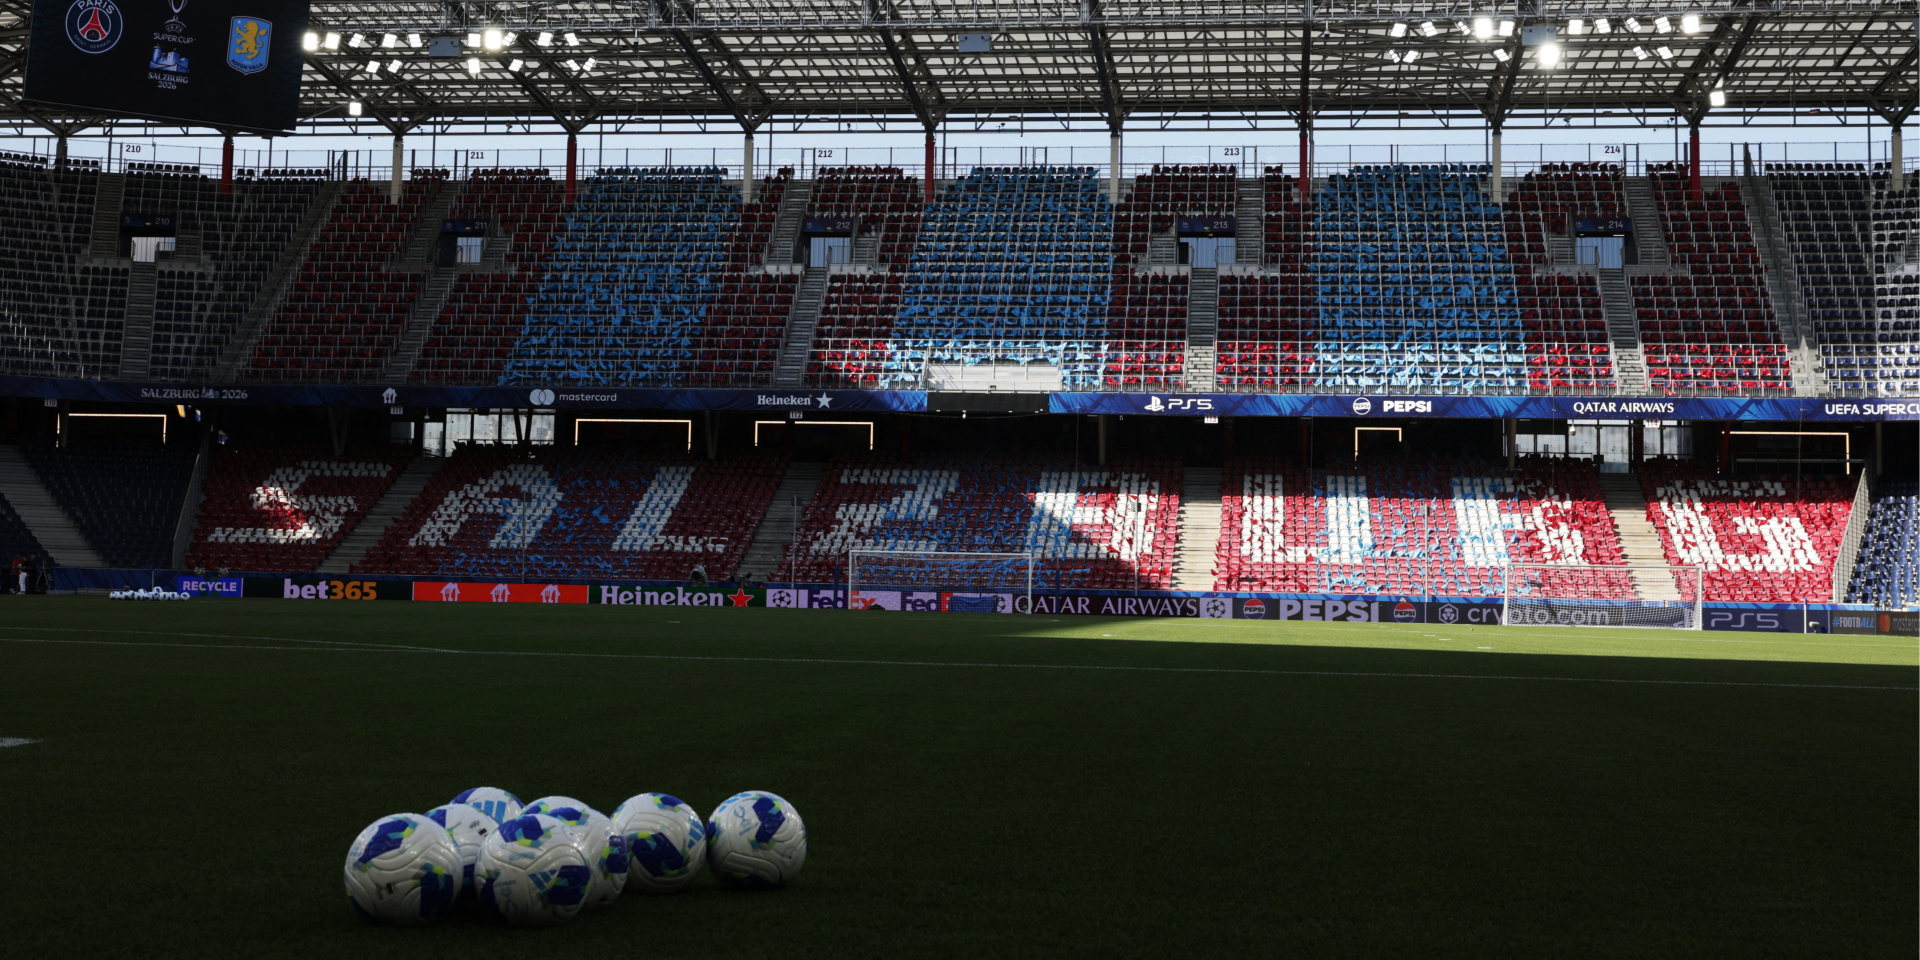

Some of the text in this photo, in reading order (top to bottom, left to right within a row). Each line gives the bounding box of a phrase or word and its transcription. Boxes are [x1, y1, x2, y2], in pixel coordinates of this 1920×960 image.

[78, 0, 114, 14] PARIS
[153, 32, 194, 44] SUPER CUP
[231, 59, 248, 69] ASTON
[248, 62, 264, 70] VILLA
[148, 72, 188, 84] SALZBURG
[158, 81, 177, 90] 2026
[125, 145, 141, 153] 210
[818, 150, 833, 158] 212
[1224, 148, 1240, 156] 213
[1604, 145, 1620, 154] 214
[471, 151, 485, 159] 211
[155, 217, 170, 226] 210
[474, 221, 488, 230] 211
[836, 221, 850, 230] 212
[1213, 220, 1228, 229] 213
[1608, 220, 1624, 229] 214
[140, 387, 248, 399] SALZBURG 2026
[559, 392, 617, 402] mastercard
[757, 395, 811, 405] Heineken
[1168, 399, 1213, 410] PS5
[1383, 400, 1432, 413] PEPSI
[1573, 402, 1675, 415] QATAR AIRWAYS
[1825, 403, 1860, 415] UEFA
[1862, 403, 1906, 415] SUPER
[182, 581, 237, 592] RECYCLE
[283, 578, 377, 601] bet365
[600, 585, 723, 606] Heineken
[808, 589, 877, 610] FedEx
[1015, 596, 1197, 616] QATAR AIRWAYS
[1280, 599, 1379, 623] PEPSI
[1467, 604, 1609, 625] crypto.com
[1711, 612, 1779, 629] PS5
[1832, 616, 1875, 628] #FOOTBALL
